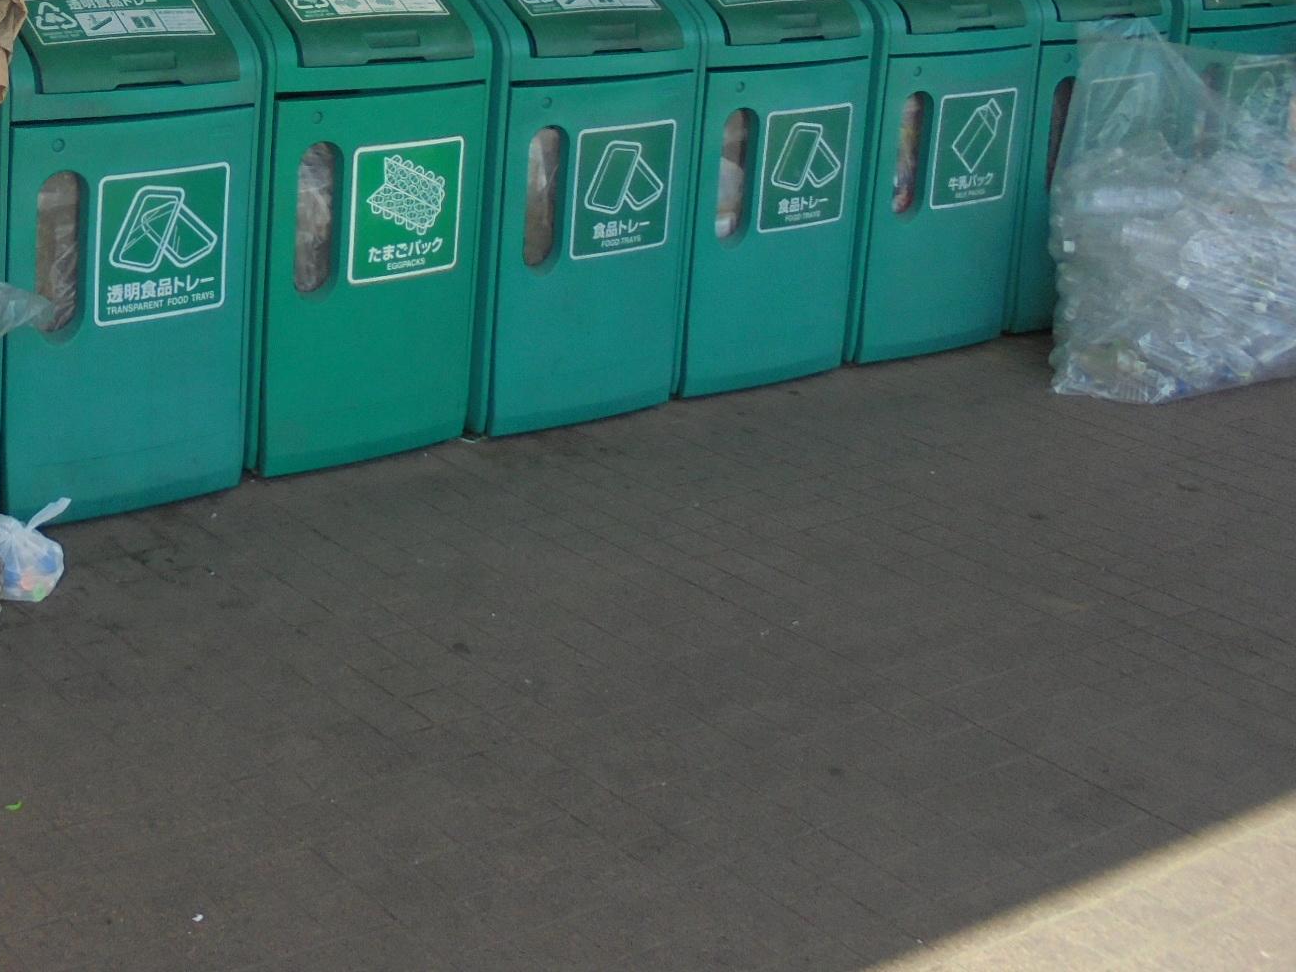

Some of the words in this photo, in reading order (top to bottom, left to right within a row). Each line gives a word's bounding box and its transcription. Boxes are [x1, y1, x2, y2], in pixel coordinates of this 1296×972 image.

[948, 172, 994, 191] 牛乳パック
[778, 196, 829, 215] 食品トレー
[593, 219, 650, 239] 食品トレー
[368, 237, 443, 263] たまごパック
[106, 275, 215, 302] 透明食品トレー
[106, 299, 163, 315] TRANSPARENT
[167, 295, 189, 306] FOOD
[191, 290, 215, 303] TRAYS
